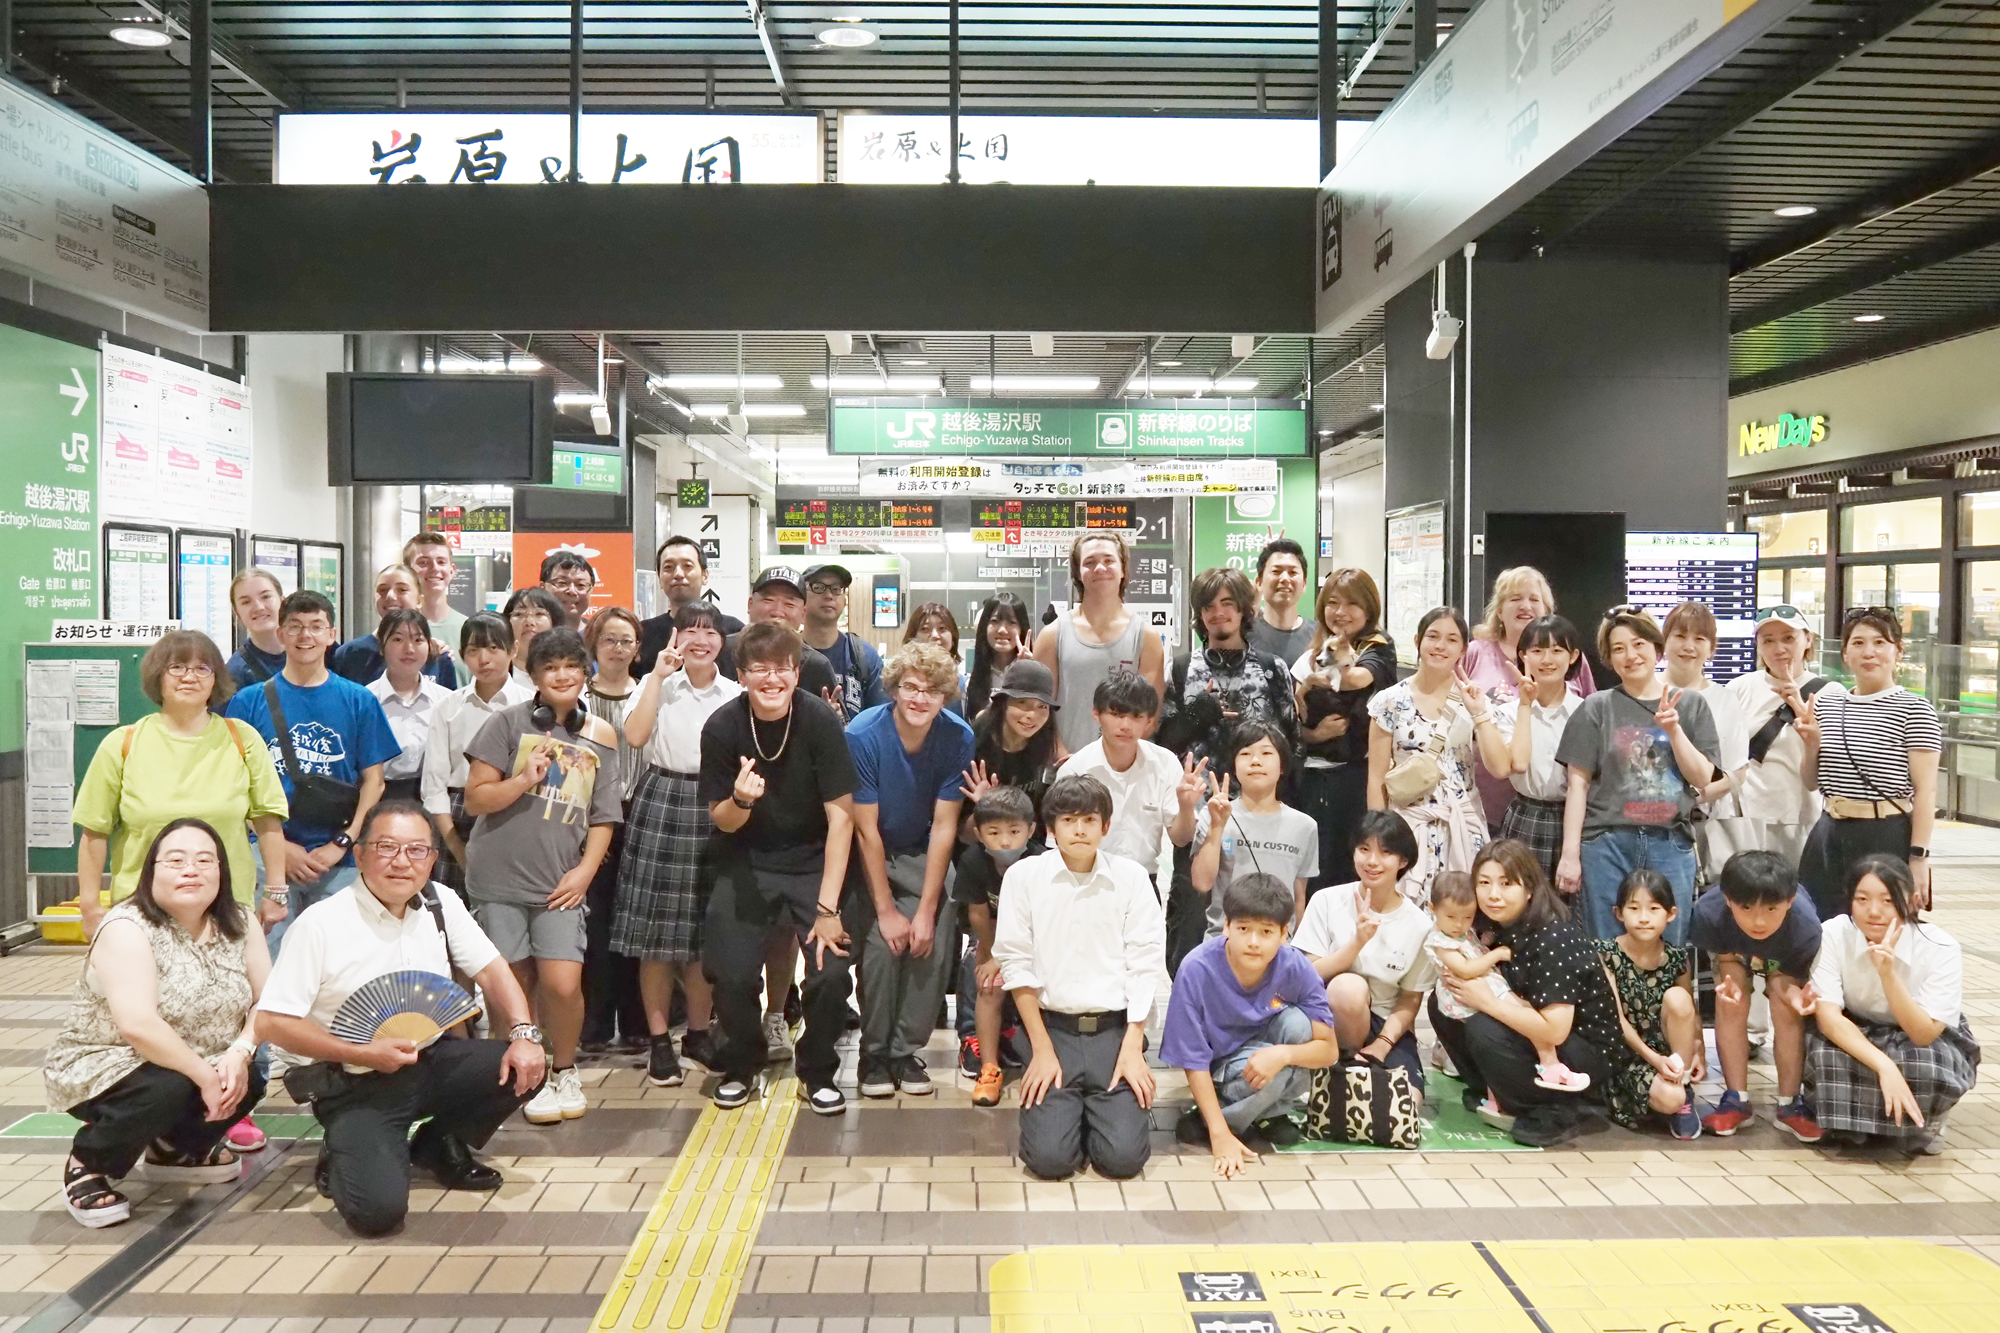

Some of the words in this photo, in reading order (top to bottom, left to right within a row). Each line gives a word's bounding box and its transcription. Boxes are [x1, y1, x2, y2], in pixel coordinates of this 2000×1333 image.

[887, 412, 936, 438] JR
[942, 412, 1042, 432] 越後湯沢駅
[1137, 413, 1253, 432] 新幹線のりば
[942, 434, 1028, 447] Echigo-Yuzawa
[1038, 434, 1072, 446] Station
[1740, 413, 1825, 456] NewDays
[893, 440, 930, 448] JR東日本
[1137, 435, 1204, 447] Shinkansen
[1209, 435, 1245, 447] Tracks
[61, 432, 90, 464] JR
[553, 454, 571, 464] 札口
[878, 466, 991, 477] 無料の利用開始登録は
[584, 473, 615, 483] ほくほく線
[897, 481, 971, 491] お済みですか?
[25, 482, 91, 513] 越後湯沢駅
[0, 511, 62, 530] Echigo-Yuzawa
[64, 516, 91, 532] Station
[1652, 536, 1730, 546] 新幹線ご案内
[53, 548, 91, 572] 改札口
[771, 568, 797, 580] UTAH
[20, 576, 40, 590] Gate
[1270, 1270, 1328, 1279] Taxi
[1192, 1291, 1262, 1301] TAXI
[1290, 1309, 1346, 1319] Bus
[1711, 1303, 1774, 1314] Taxi
